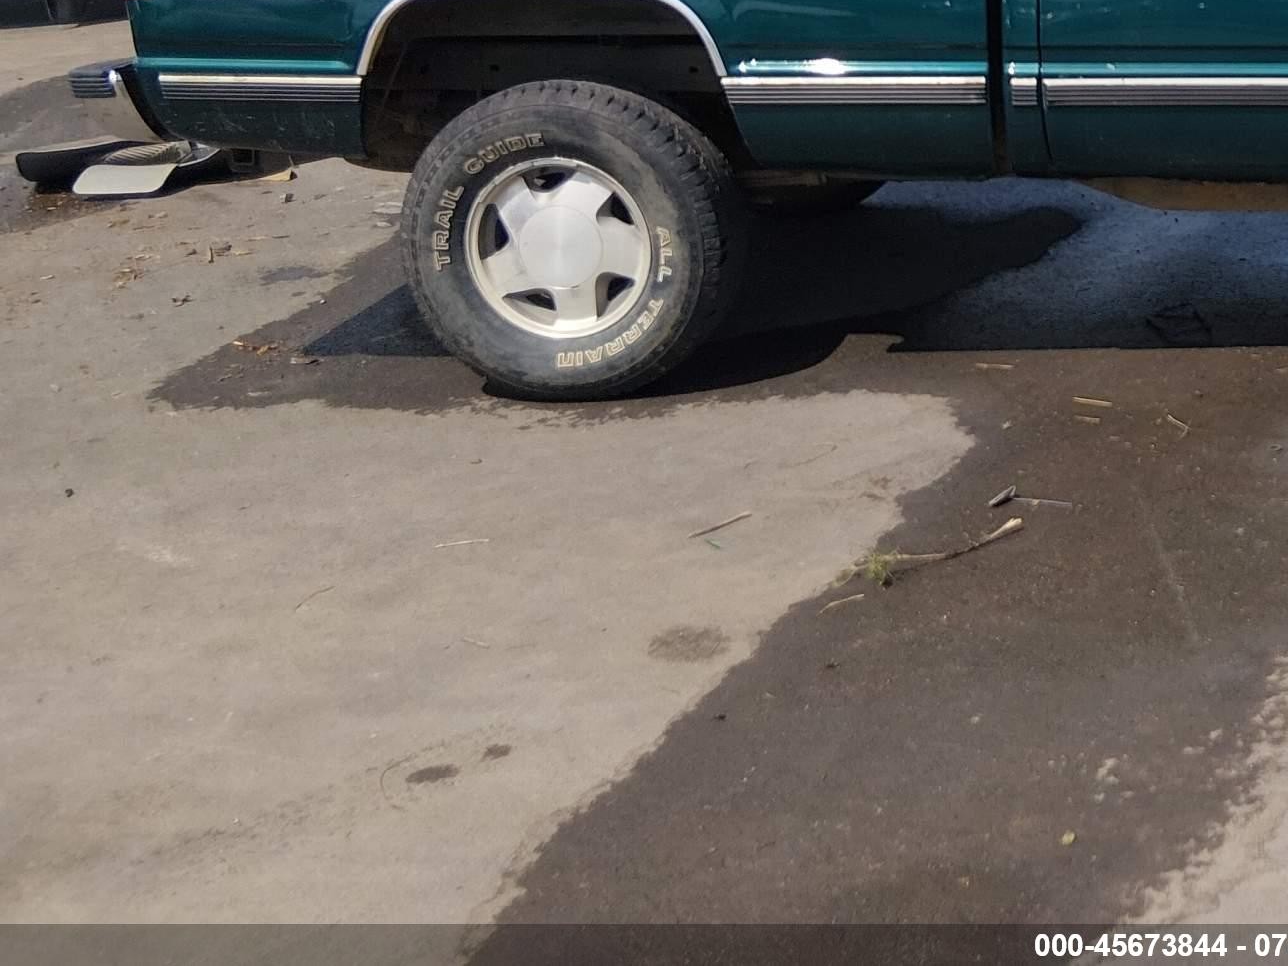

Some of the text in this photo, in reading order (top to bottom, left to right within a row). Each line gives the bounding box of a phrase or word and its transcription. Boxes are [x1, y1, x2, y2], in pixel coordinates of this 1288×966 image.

[431, 132, 546, 272] TRAIL GUIDE
[556, 225, 673, 370] ALL TERRAIN
